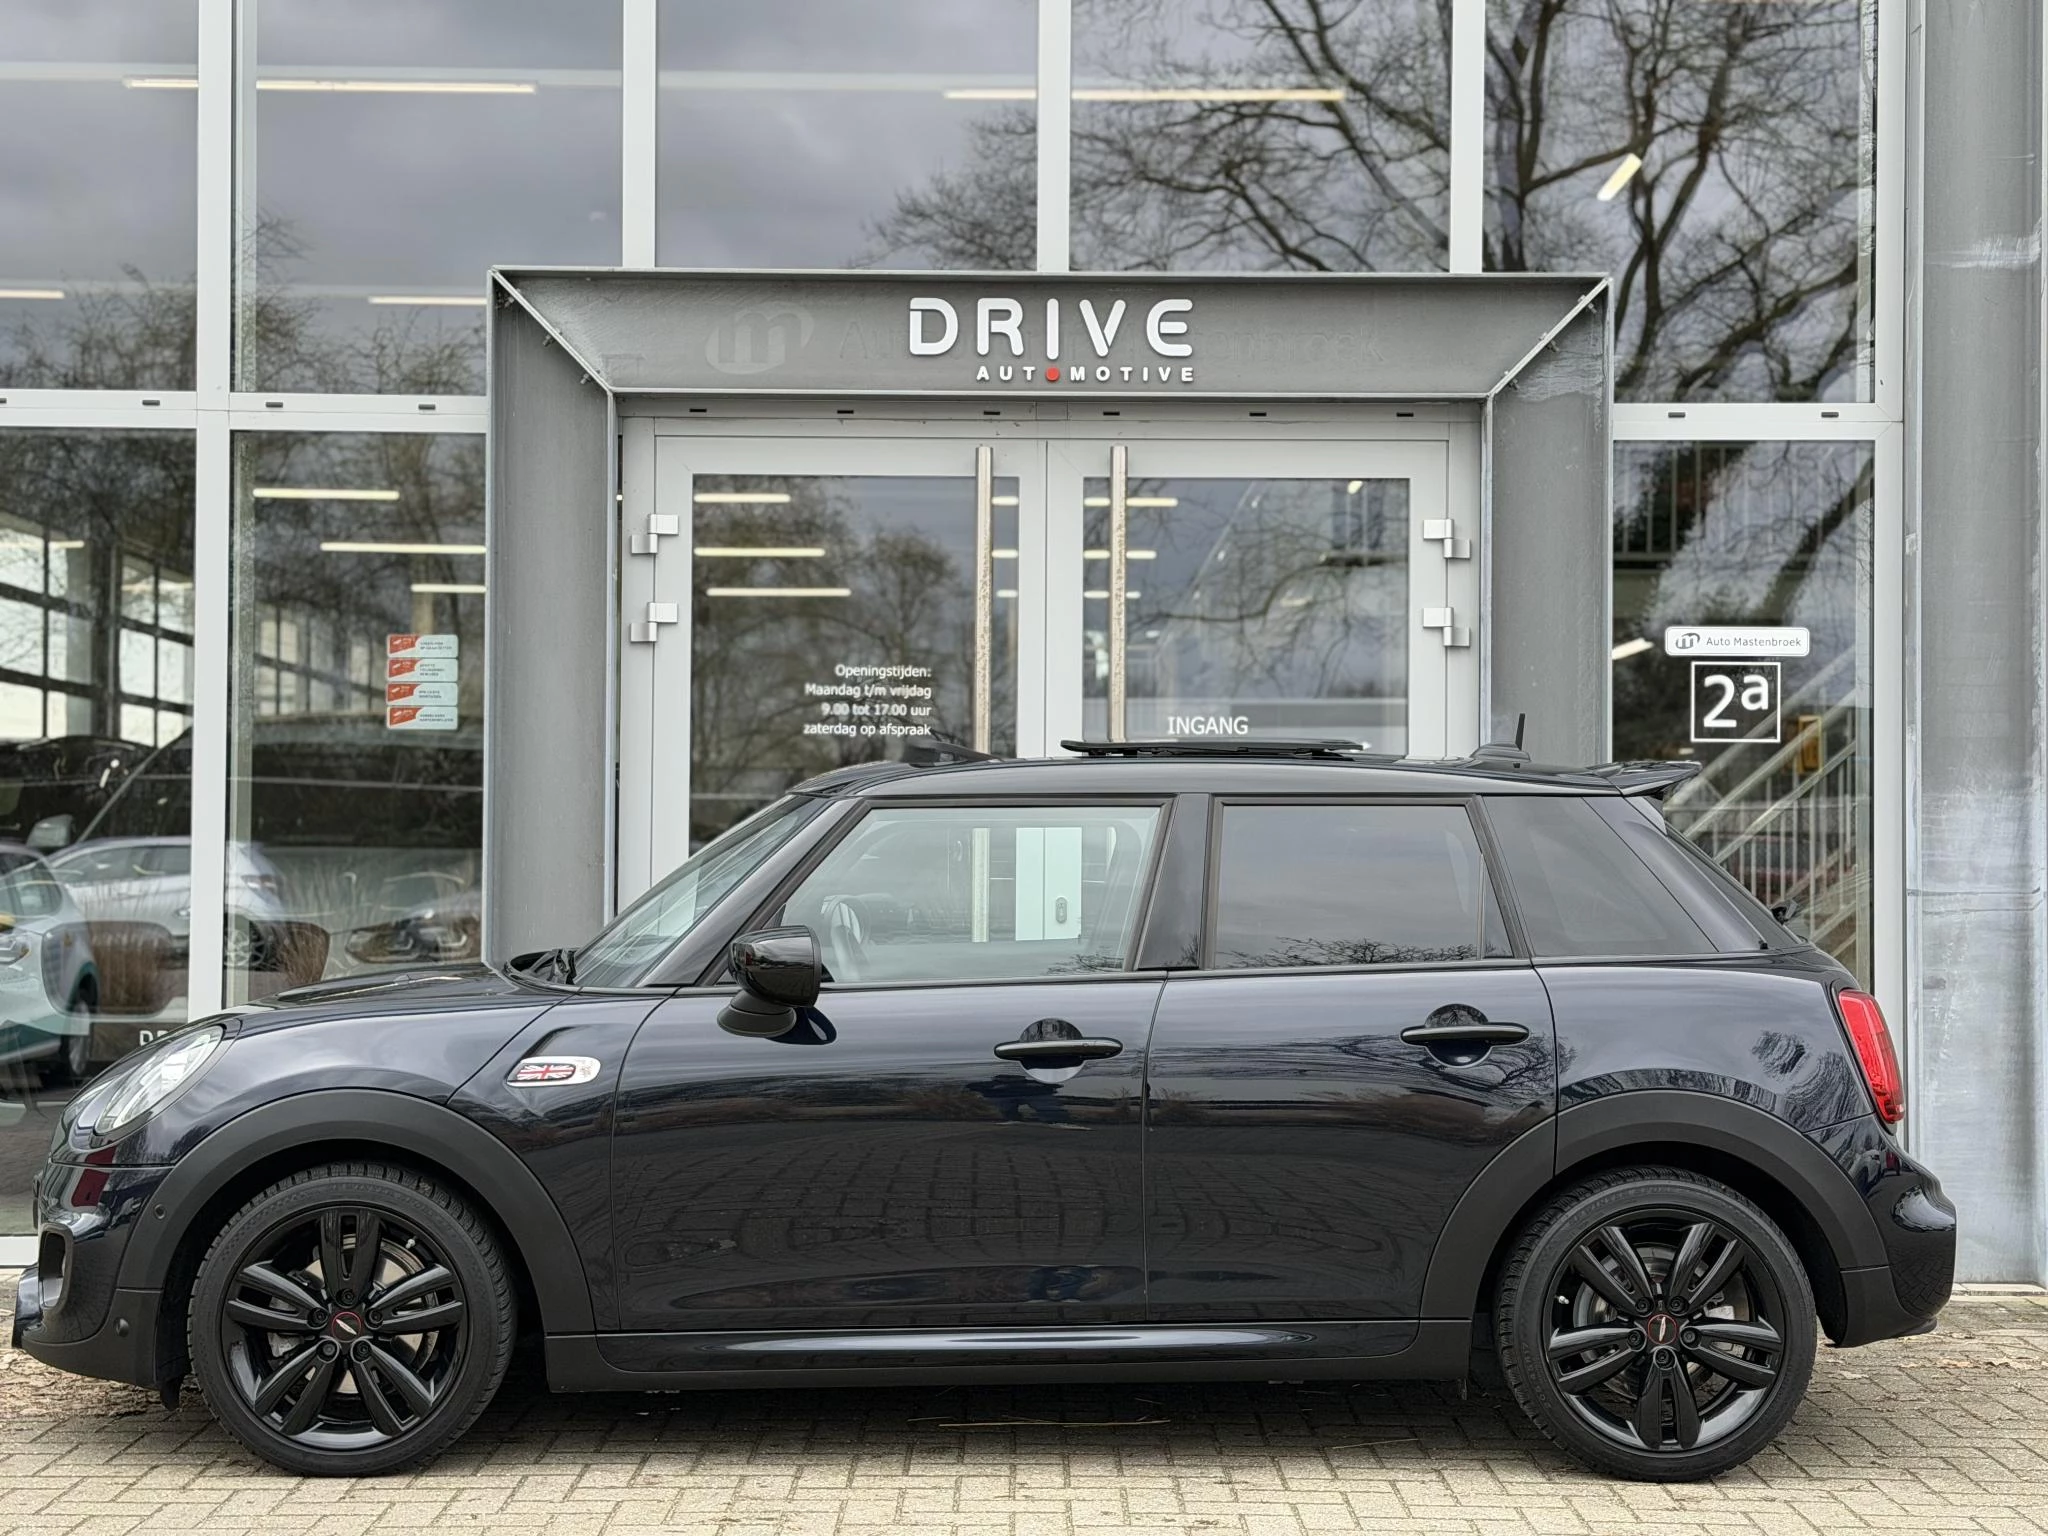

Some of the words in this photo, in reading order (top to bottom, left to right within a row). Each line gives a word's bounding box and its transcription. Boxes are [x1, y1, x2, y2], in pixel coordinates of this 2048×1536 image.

[909, 297, 1193, 360] DRIVE
[1706, 636, 1731, 647] Auto
[1733, 636, 1802, 647] Mastenbroek
[834, 663, 932, 679] Openingstijden:
[804, 683, 861, 698] Maandag
[864, 684, 887, 697] t/m
[890, 684, 932, 699] vrijdag
[820, 702, 850, 716] 9.00
[852, 703, 870, 716] tot
[874, 703, 907, 716] 17.00
[910, 705, 932, 716] uur
[803, 722, 856, 737] zaterdag
[860, 726, 876, 737] op
[879, 722, 932, 737] afspraak
[1167, 715, 1249, 735] INGANG
